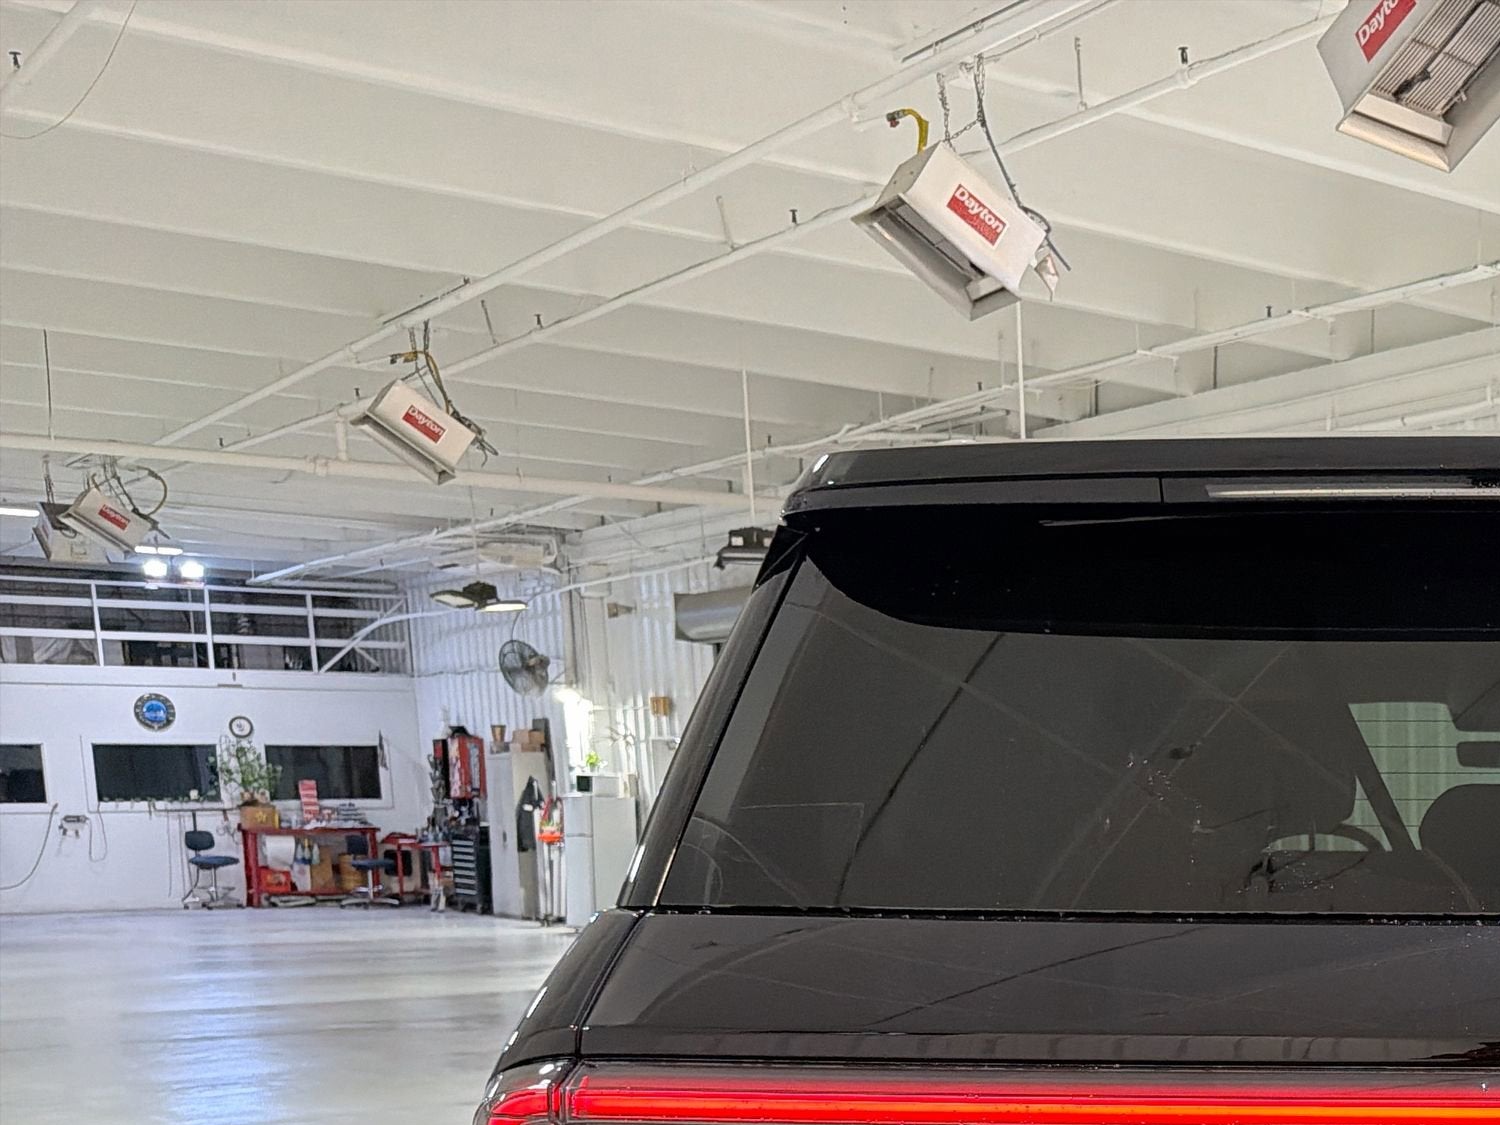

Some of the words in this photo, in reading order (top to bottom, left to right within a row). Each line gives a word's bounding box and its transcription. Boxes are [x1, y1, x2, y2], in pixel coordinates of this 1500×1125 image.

[1358, 0, 1399, 47] Dayto
[954, 187, 1004, 233] Dayton
[407, 407, 444, 436] Dayton
